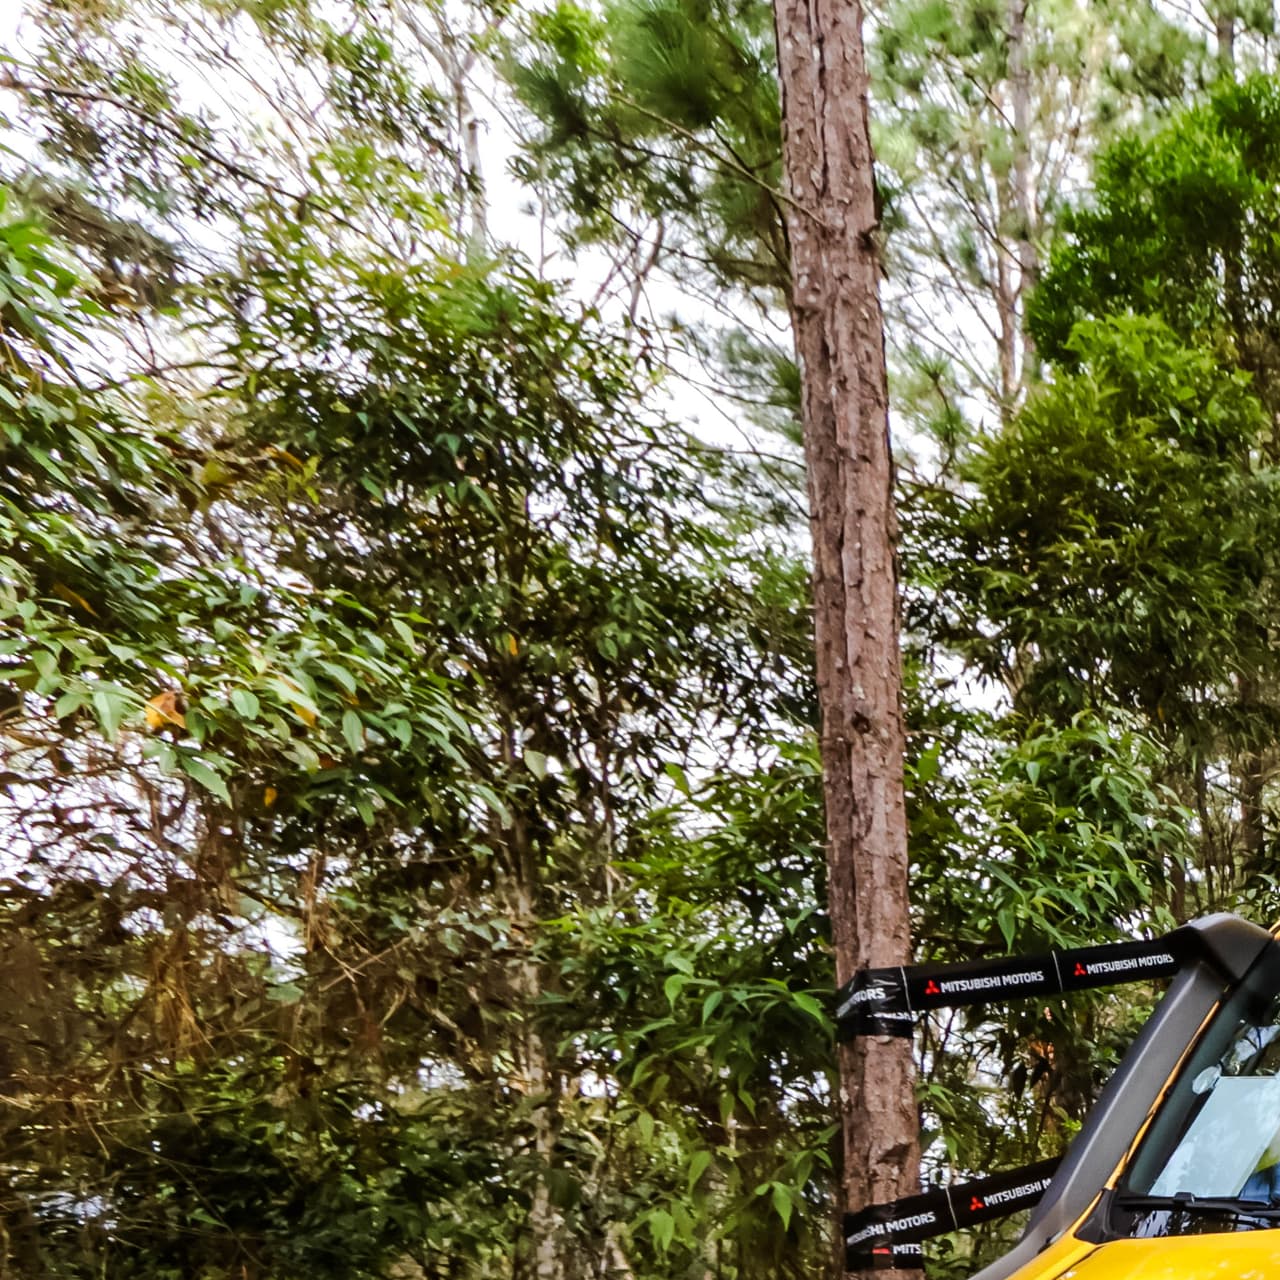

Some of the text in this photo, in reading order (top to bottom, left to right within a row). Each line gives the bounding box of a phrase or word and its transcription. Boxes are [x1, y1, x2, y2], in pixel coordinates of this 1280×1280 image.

[1086, 953, 1174, 975] MITSUBISHI MOTORS
[941, 971, 1045, 993] MITSUBISHI MOTORS
[984, 1181, 1042, 1207] MITSUBISHI
[885, 1211, 936, 1233] MOTORS
